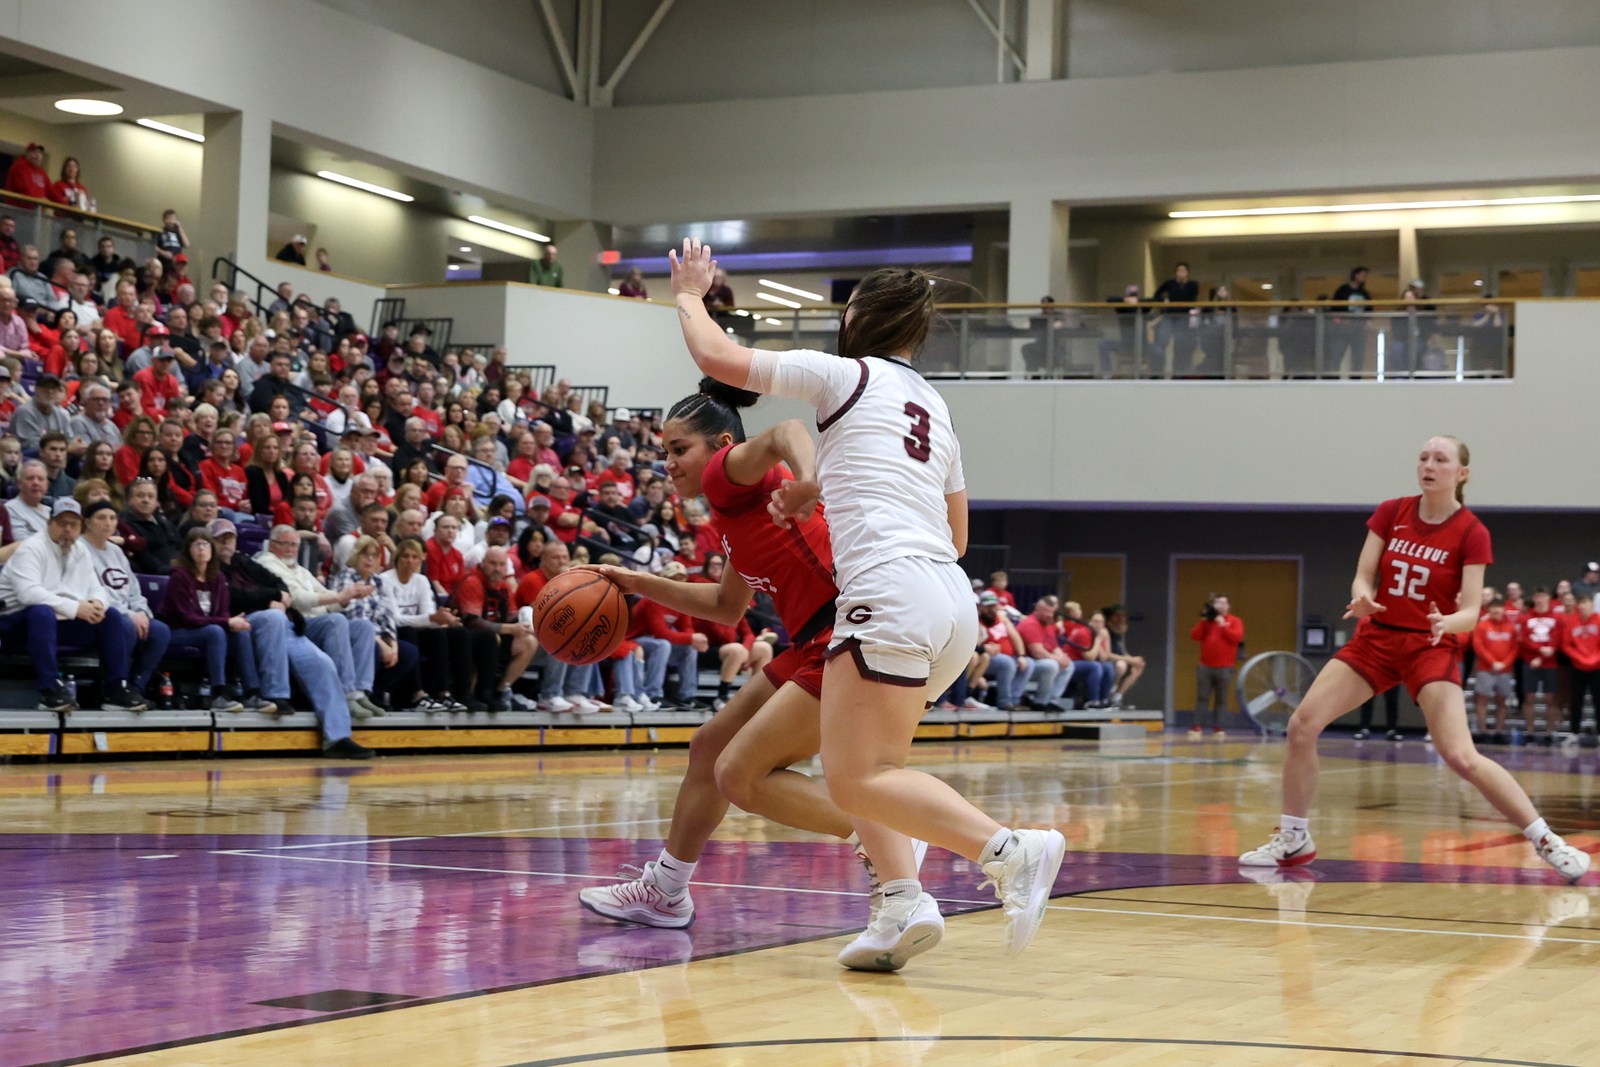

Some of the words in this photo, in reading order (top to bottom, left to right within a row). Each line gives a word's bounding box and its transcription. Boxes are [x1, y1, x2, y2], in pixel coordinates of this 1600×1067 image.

[903, 401, 931, 463] 3
[1387, 537, 1450, 565] BELLEVUE
[102, 568, 129, 590] G
[1387, 559, 1431, 601] 32
[551, 607, 575, 632] OHSAA
[845, 604, 873, 625] G
[571, 614, 611, 663] Rawlings
